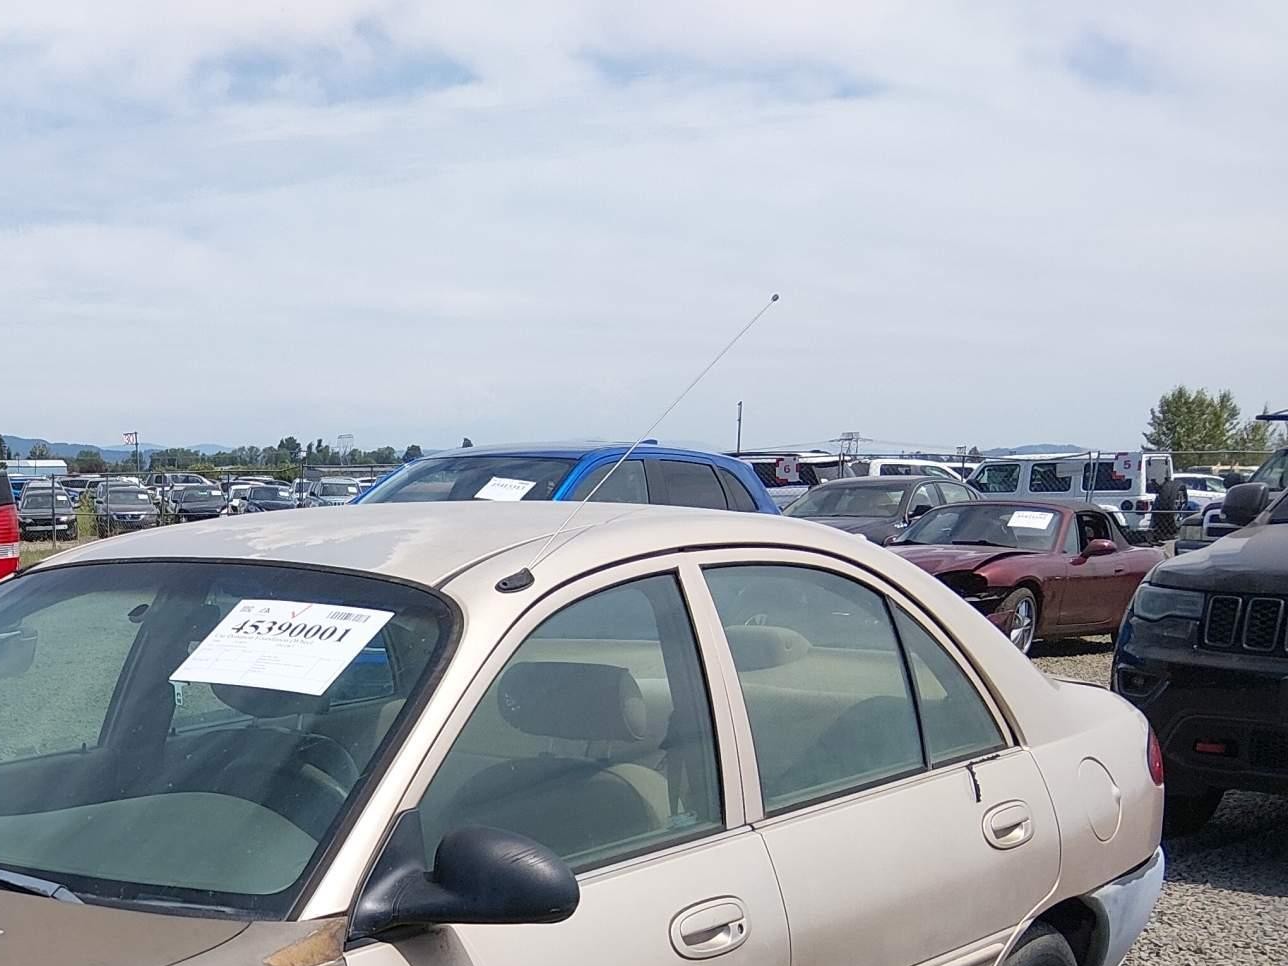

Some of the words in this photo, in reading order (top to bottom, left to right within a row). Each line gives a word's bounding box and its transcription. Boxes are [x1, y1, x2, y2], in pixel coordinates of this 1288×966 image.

[783, 464, 791, 474] 6
[1123, 460, 1132, 470] 5
[231, 619, 352, 642] 45390001
